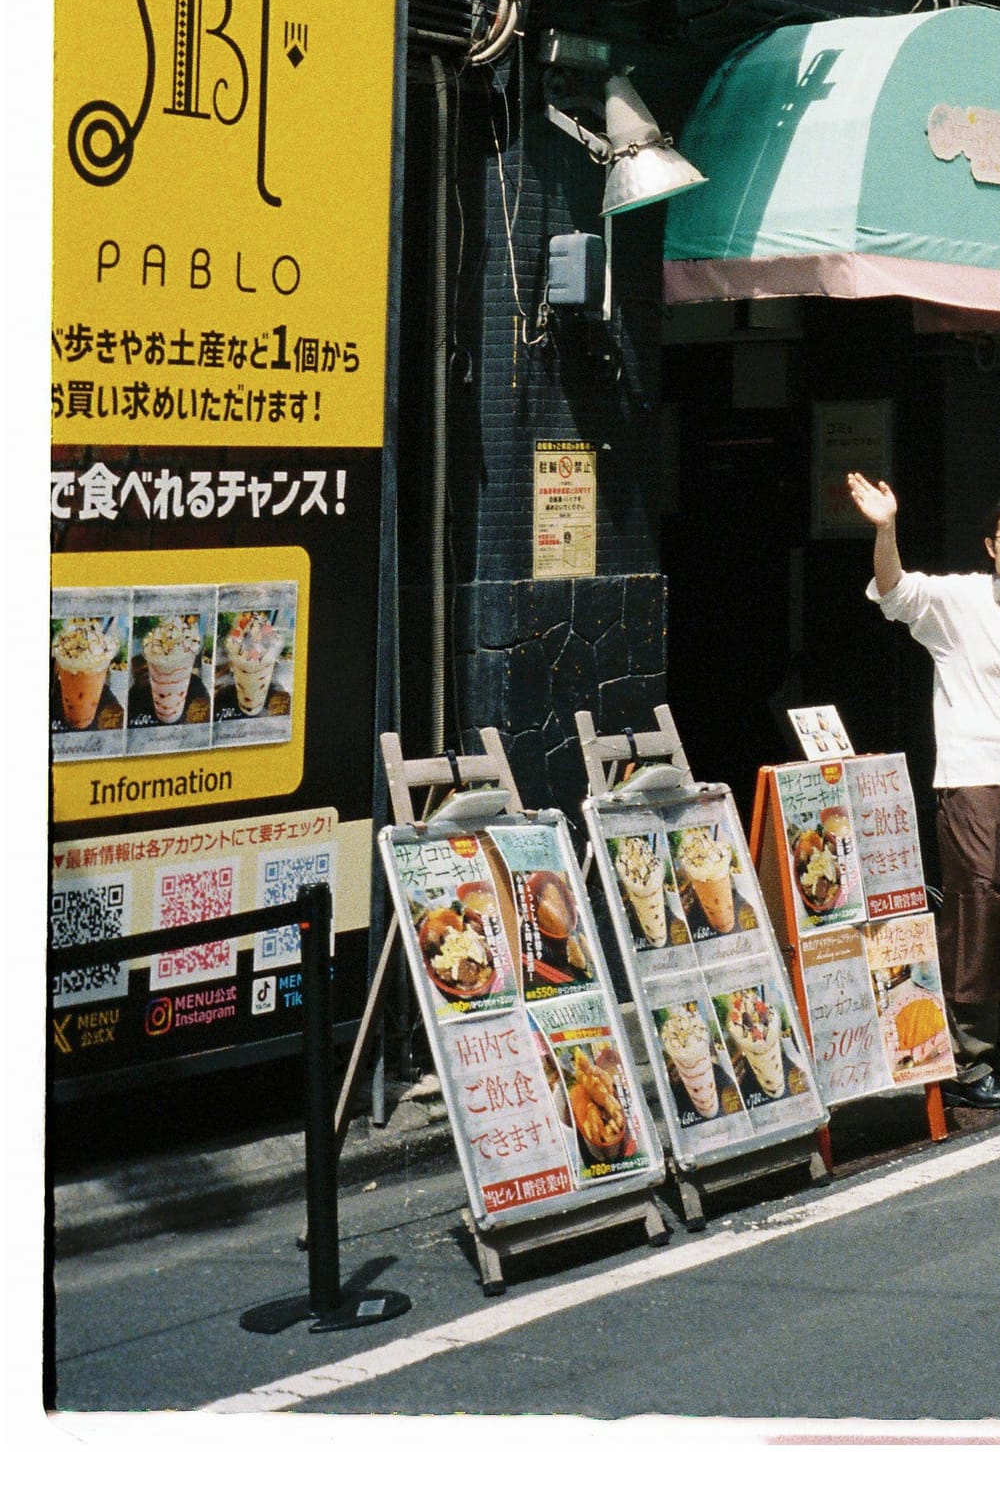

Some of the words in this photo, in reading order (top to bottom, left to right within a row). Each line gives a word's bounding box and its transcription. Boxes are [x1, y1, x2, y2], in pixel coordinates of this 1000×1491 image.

[97, 239, 301, 296] PABLO
[50, 461, 347, 521] で食べれるチャンス!
[89, 767, 232, 805] Information
[781, 772, 822, 789] サイコロ
[856, 769, 900, 799] 店内で
[786, 787, 843, 811] ステーキ丼
[860, 804, 910, 838] ご飲食
[65, 815, 333, 869] 最新情報は各アカウントにて要チェック!
[395, 843, 452, 868] サイコロ
[401, 861, 484, 887] ステーキ丼
[862, 843, 919, 876] できます!
[882, 943, 926, 962] オムライス
[77, 1009, 120, 1027] MENU
[175, 1005, 236, 1027] Instagram
[456, 1028, 519, 1067] 店内で
[823, 1019, 874, 1062] 50%
[464, 1070, 539, 1114] ご飲食
[471, 1116, 557, 1160] できます!
[483, 1170, 570, 1208] 当ビル1階営業中
